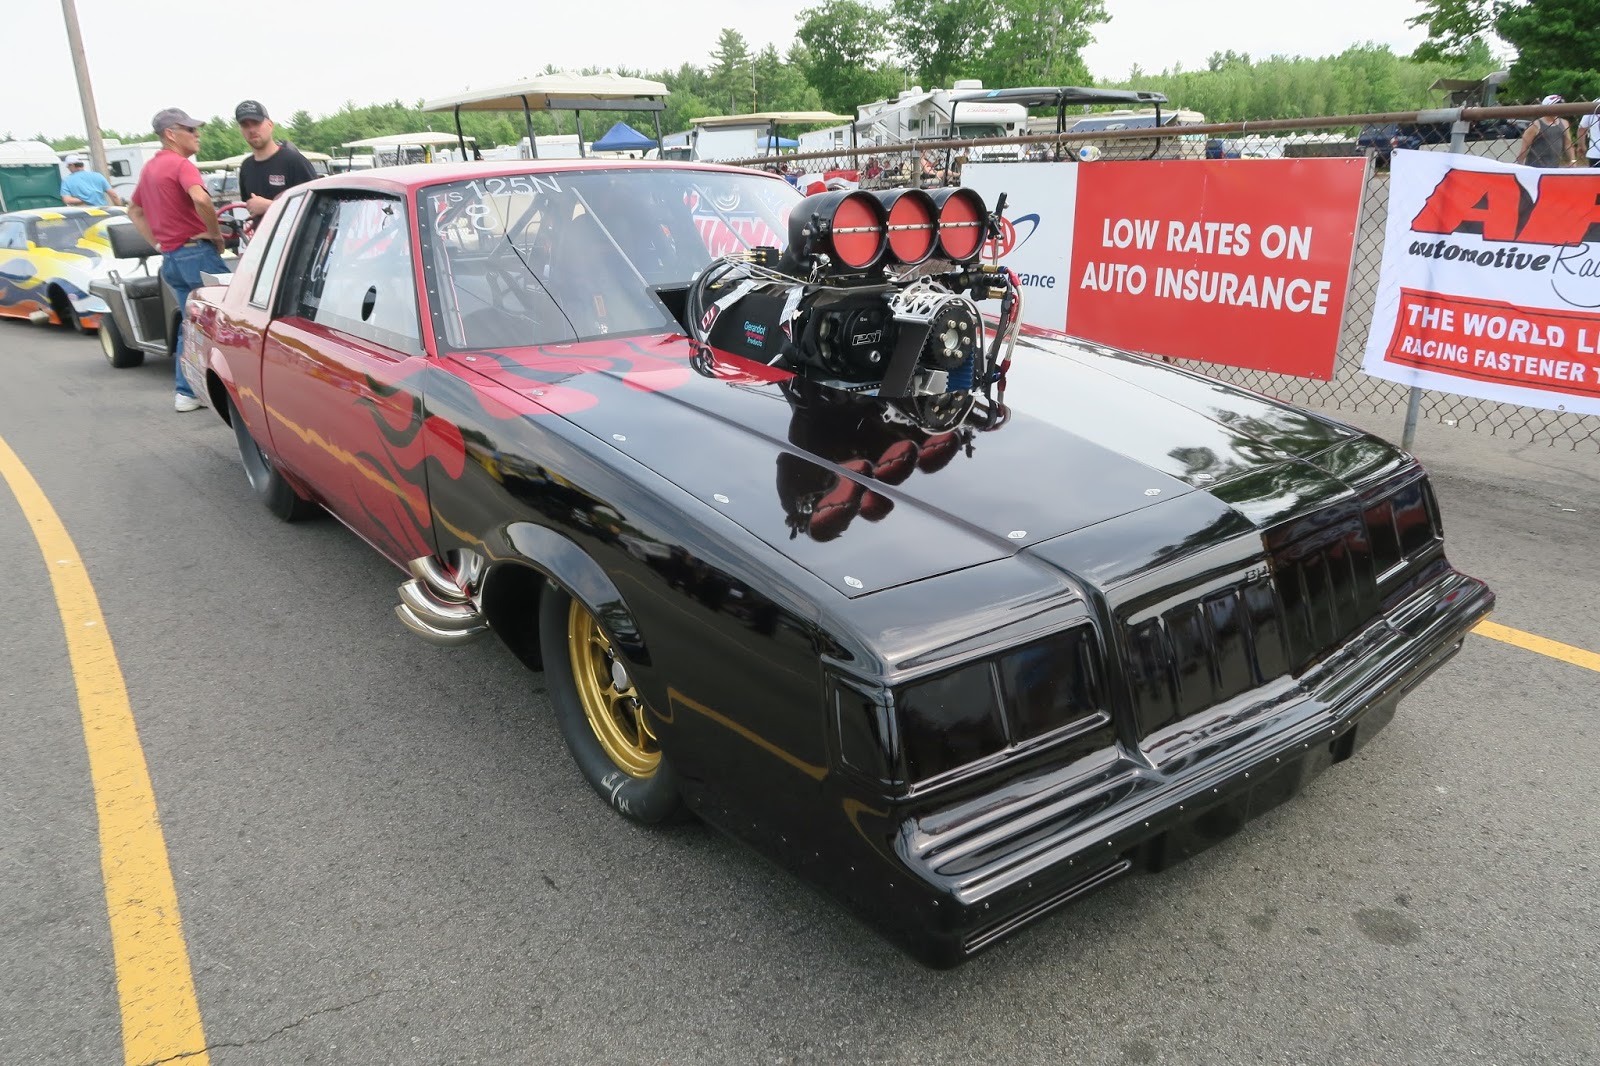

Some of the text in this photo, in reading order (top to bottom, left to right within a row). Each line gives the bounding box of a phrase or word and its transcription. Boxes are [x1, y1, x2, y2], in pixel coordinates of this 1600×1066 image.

[465, 175, 563, 200] 125N
[1102, 218, 1313, 261] LOW RATES ON
[1409, 240, 1551, 271] automotive
[1080, 261, 1331, 315] AUTO INSURANCE
[1408, 304, 1600, 355] THE WORLD L
[1401, 336, 1469, 364] RACING
[1474, 349, 1585, 382] FASTENER
